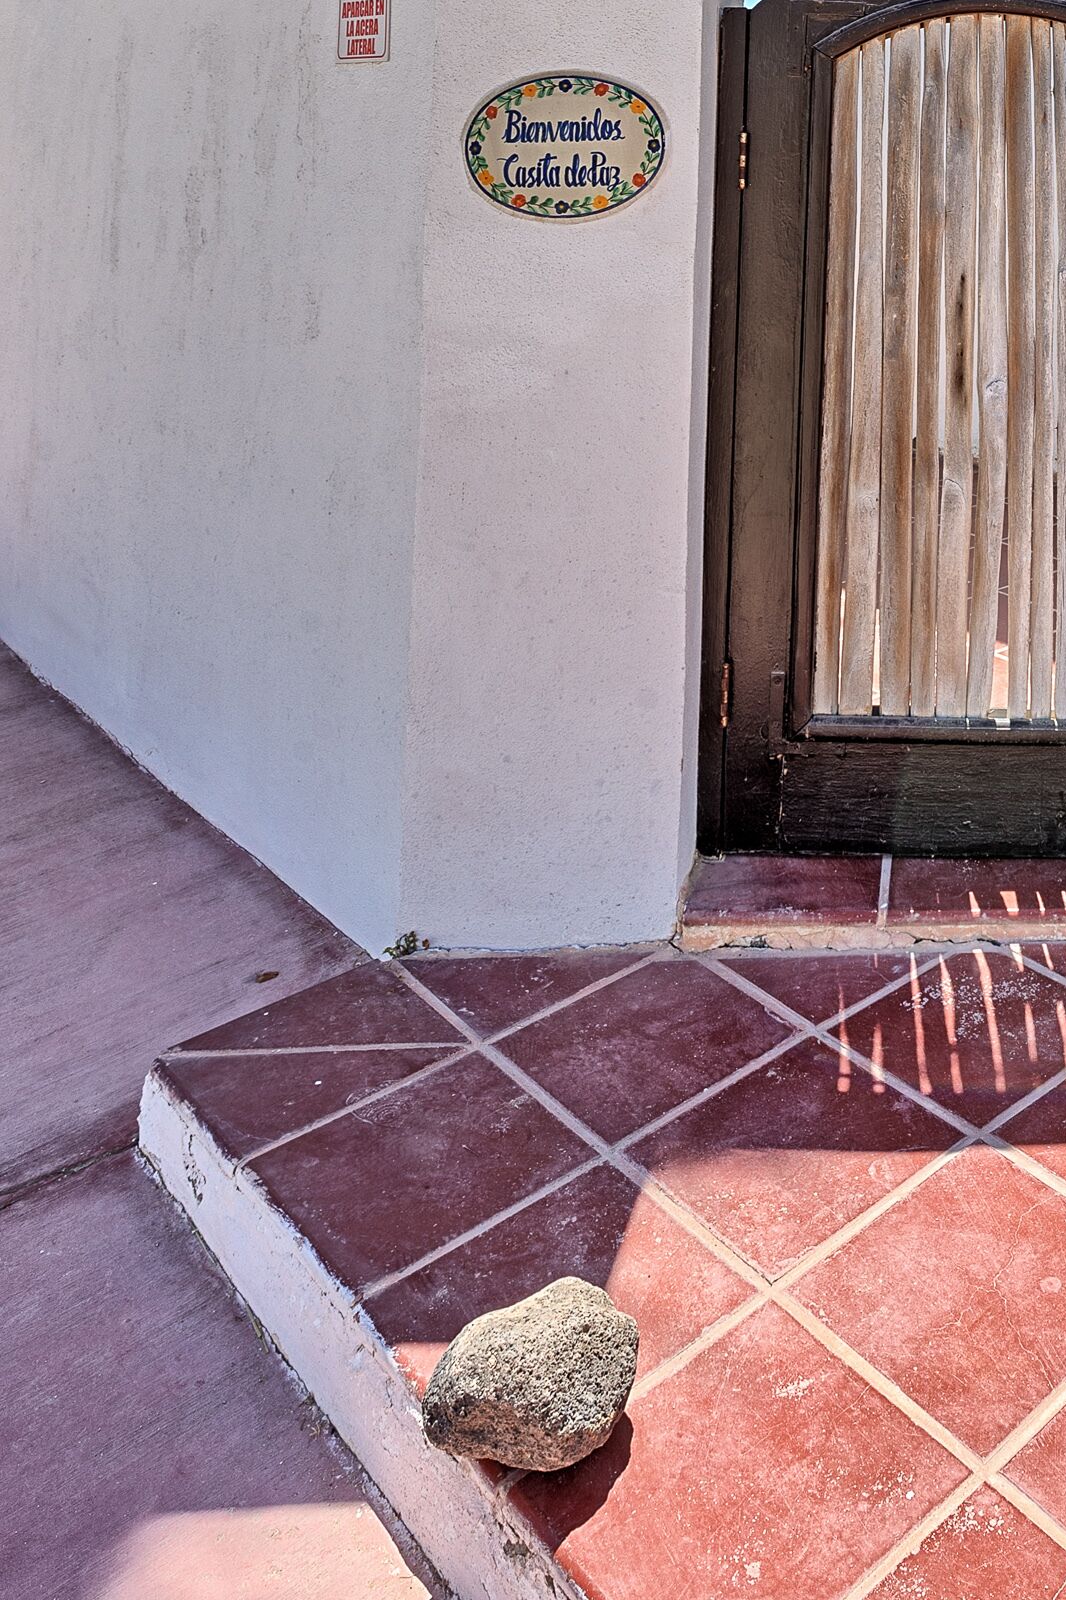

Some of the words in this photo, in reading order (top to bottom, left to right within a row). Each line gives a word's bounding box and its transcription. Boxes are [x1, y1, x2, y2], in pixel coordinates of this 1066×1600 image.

[342, 0, 374, 18] APARCAR
[346, 21, 354, 37] LA
[355, 19, 379, 36] ACERA
[347, 38, 375, 55] LATERAL
[502, 108, 625, 143] Bienvenidos
[497, 153, 561, 188] Casita
[564, 153, 587, 188] de
[587, 151, 625, 192] Paz
